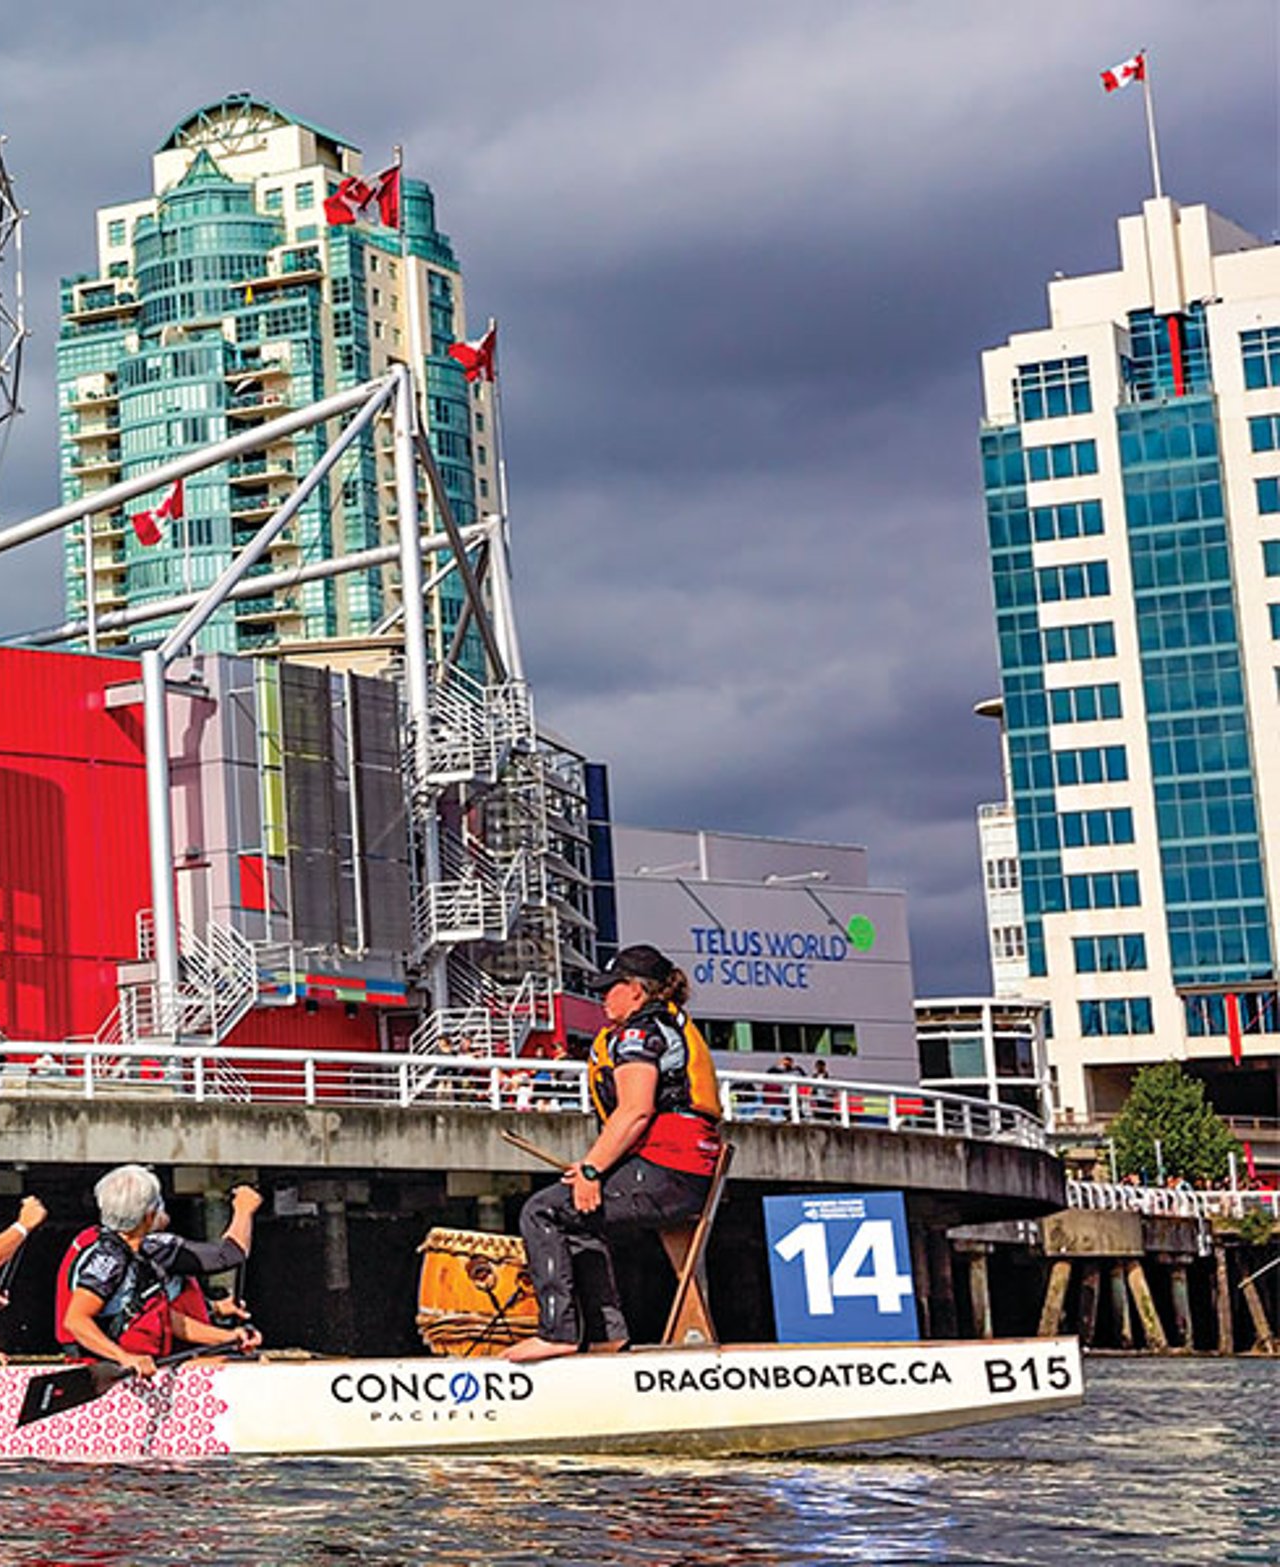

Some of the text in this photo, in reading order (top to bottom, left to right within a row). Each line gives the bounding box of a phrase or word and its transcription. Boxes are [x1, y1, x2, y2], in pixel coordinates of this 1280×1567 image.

[691, 927, 847, 961] TELUS WORLD
[694, 958, 809, 988] of SCIENCE
[775, 1219, 913, 1314] 14
[634, 1361, 953, 1393] DRAGONBOATBC.CA
[984, 1356, 1072, 1394] B15
[370, 1409, 498, 1422] PACIFIC
